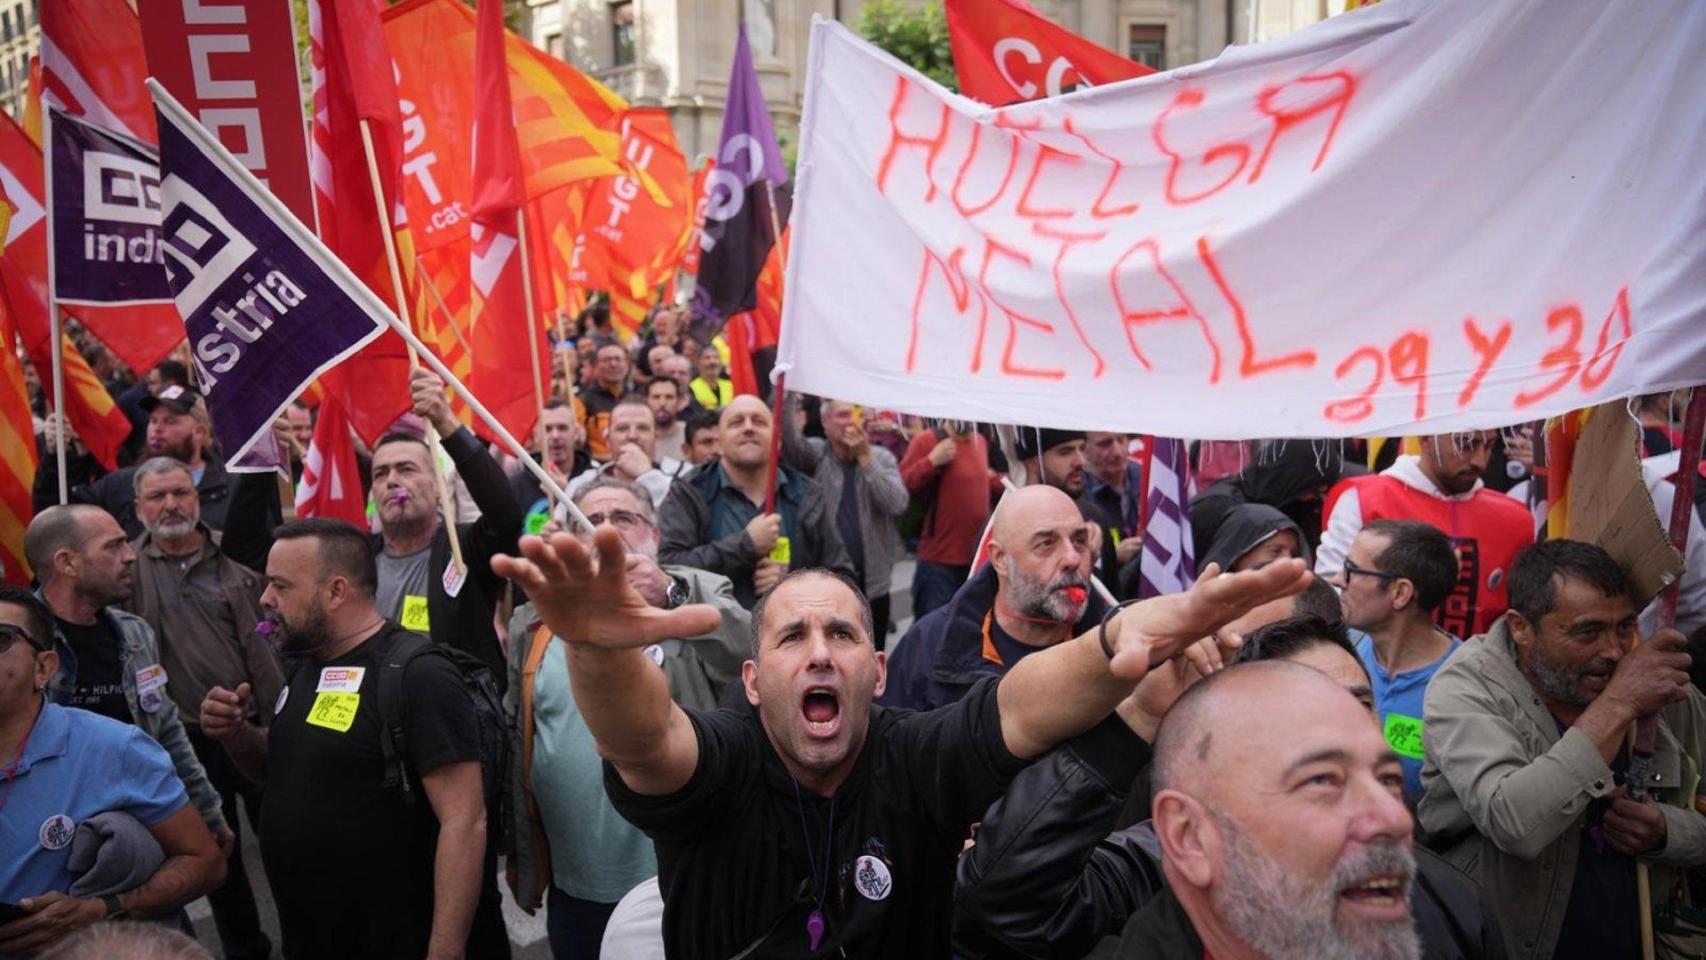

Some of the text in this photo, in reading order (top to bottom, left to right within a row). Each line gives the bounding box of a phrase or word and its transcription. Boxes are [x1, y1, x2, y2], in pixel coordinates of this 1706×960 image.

[877, 67, 1358, 221] HUELGA
[425, 201, 468, 234] .cat
[906, 222, 1317, 384] METAL
[1323, 331, 1430, 423] 29
[1514, 286, 1634, 409] 30
